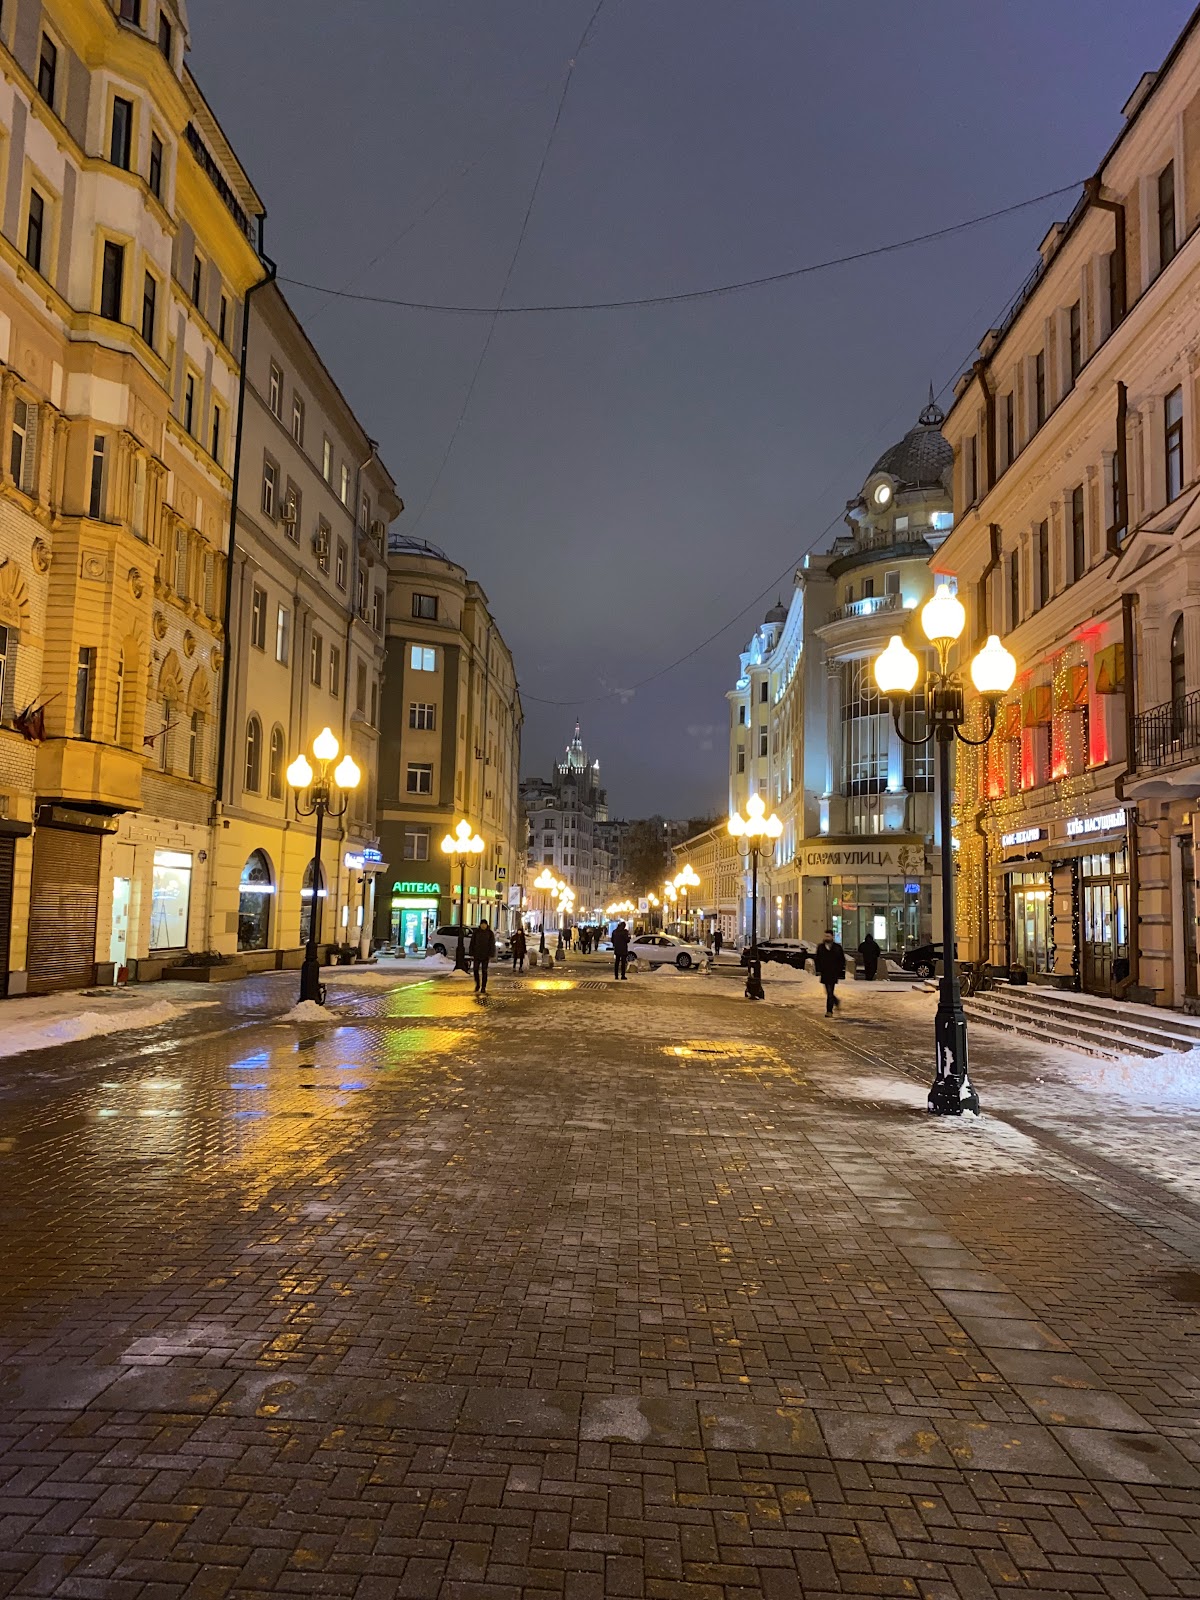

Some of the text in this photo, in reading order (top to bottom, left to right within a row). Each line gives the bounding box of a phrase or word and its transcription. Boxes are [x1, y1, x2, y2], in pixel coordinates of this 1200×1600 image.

[1084, 808, 1126, 832] НАСУЩНЫЙ
[807, 851, 893, 866] СТАРАЯ УЛИЦА
[392, 881, 440, 893] АПТЕКА
